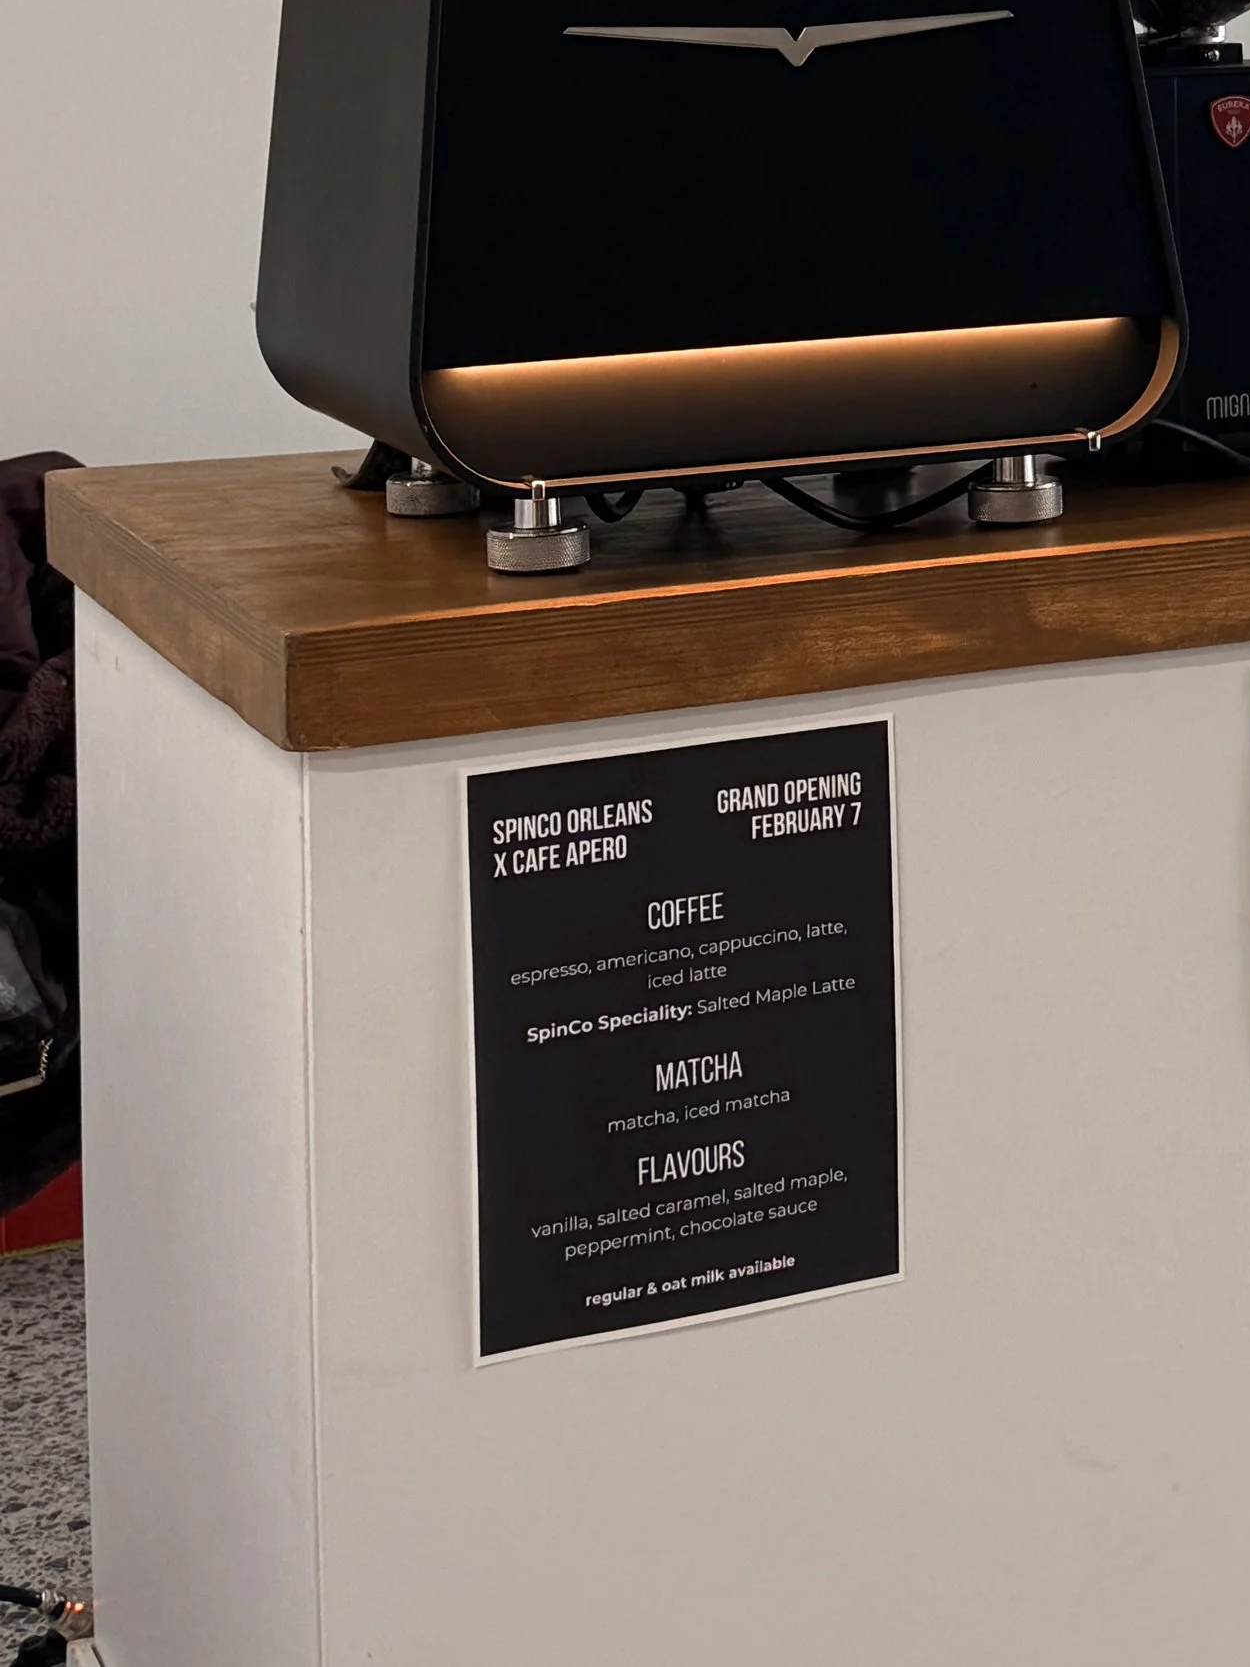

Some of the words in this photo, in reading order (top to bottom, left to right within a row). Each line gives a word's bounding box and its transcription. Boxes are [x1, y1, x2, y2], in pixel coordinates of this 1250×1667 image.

[716, 782, 779, 814] GRAND
[783, 771, 861, 804] OPENING
[492, 811, 562, 845] SPINCO
[566, 798, 653, 833] ORLEANS
[751, 803, 845, 840] FEBRUARY
[849, 801, 862, 826] 7
[493, 851, 508, 878] X
[512, 843, 561, 875] CAFE
[565, 834, 627, 867] APERO
[647, 891, 724, 930] COFFEE
[510, 962, 592, 986] espresso,
[596, 946, 695, 971] americano,
[698, 928, 802, 956] cappuccino,
[806, 921, 847, 939] latte,
[647, 968, 684, 989] iced
[689, 965, 727, 982] latte
[526, 1019, 593, 1044] SpinCo
[597, 1003, 692, 1032] Speciality:
[696, 991, 750, 1014] Salted
[755, 983, 807, 1004] Maple
[812, 978, 855, 995] Latte
[655, 1050, 743, 1092] MATCHA
[607, 1109, 680, 1133] matcha,
[684, 1099, 720, 1120] iced
[725, 1089, 790, 1112] matcha
[638, 1139, 745, 1186] FLAVOURS
[530, 1215, 593, 1238] vanilla,
[596, 1202, 651, 1226] salted
[655, 1188, 730, 1216] caramel,
[733, 1176, 785, 1201] salted
[790, 1167, 848, 1190] maple,
[564, 1226, 675, 1261] peppermint,
[679, 1209, 765, 1237] chocolate
[767, 1199, 818, 1220] sauce
[585, 1286, 643, 1307] regular
[646, 1281, 658, 1295] &
[661, 1276, 687, 1292] oat
[690, 1268, 725, 1287] milk
[728, 1254, 796, 1279] available
